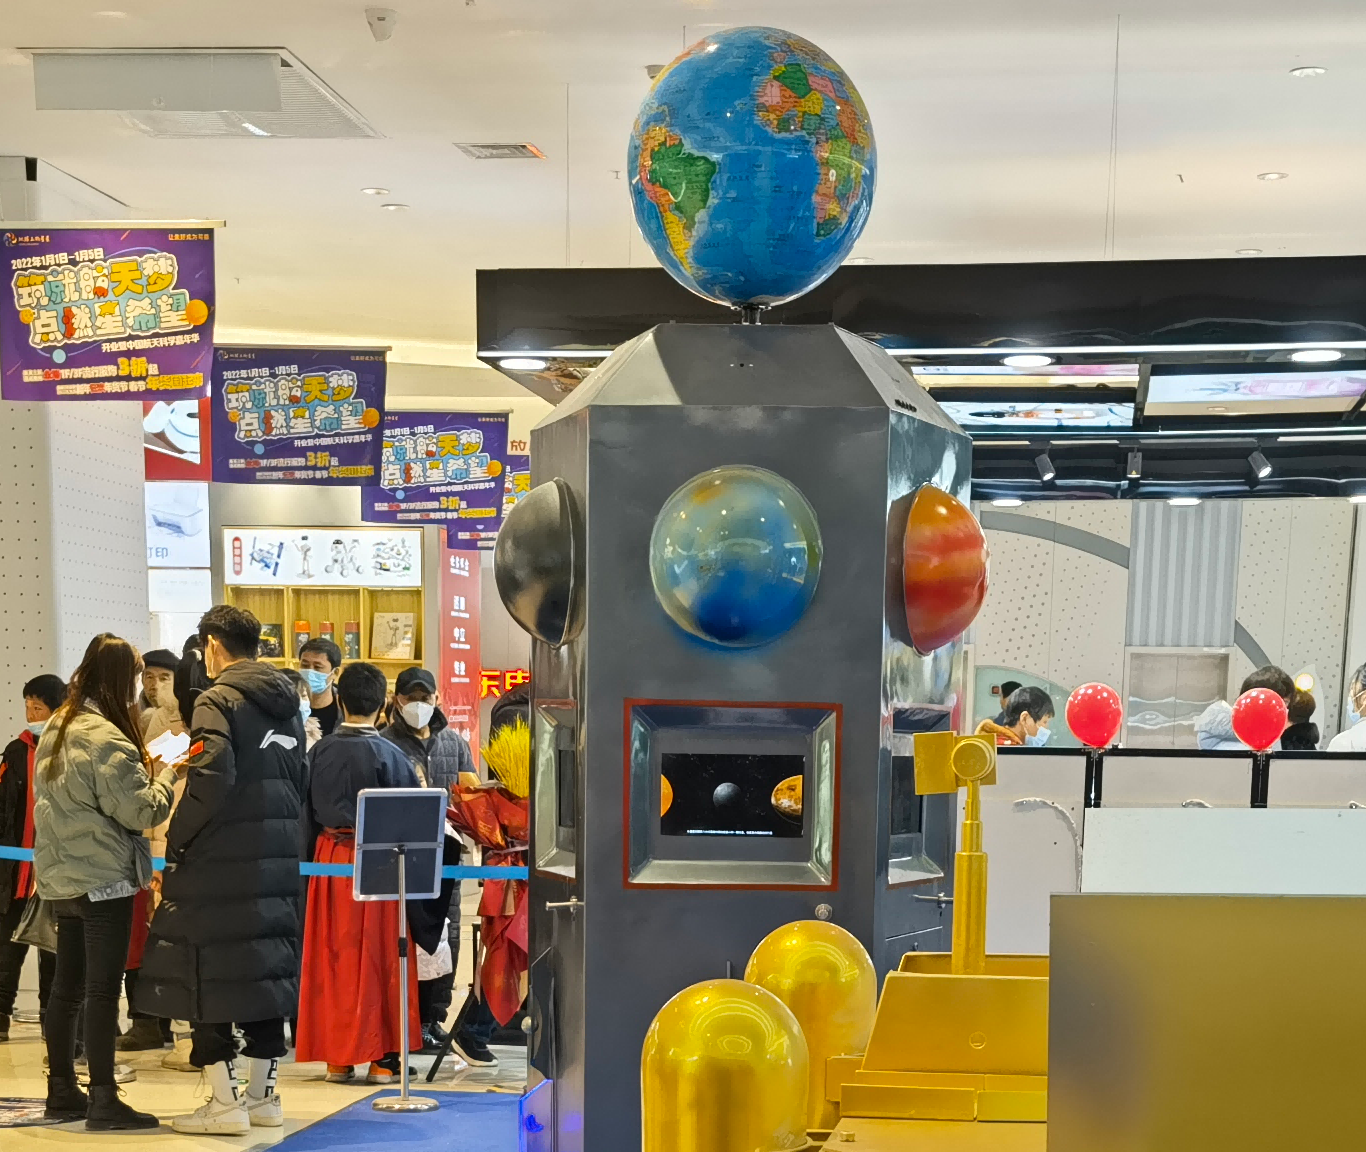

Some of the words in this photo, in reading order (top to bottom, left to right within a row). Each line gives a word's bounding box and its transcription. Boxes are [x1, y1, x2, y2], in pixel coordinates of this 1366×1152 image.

[11, 248, 105, 270] 2022年1月1日-1月5日
[32, 292, 189, 343] 点燃星希望
[238, 401, 365, 438] 点燃星希望
